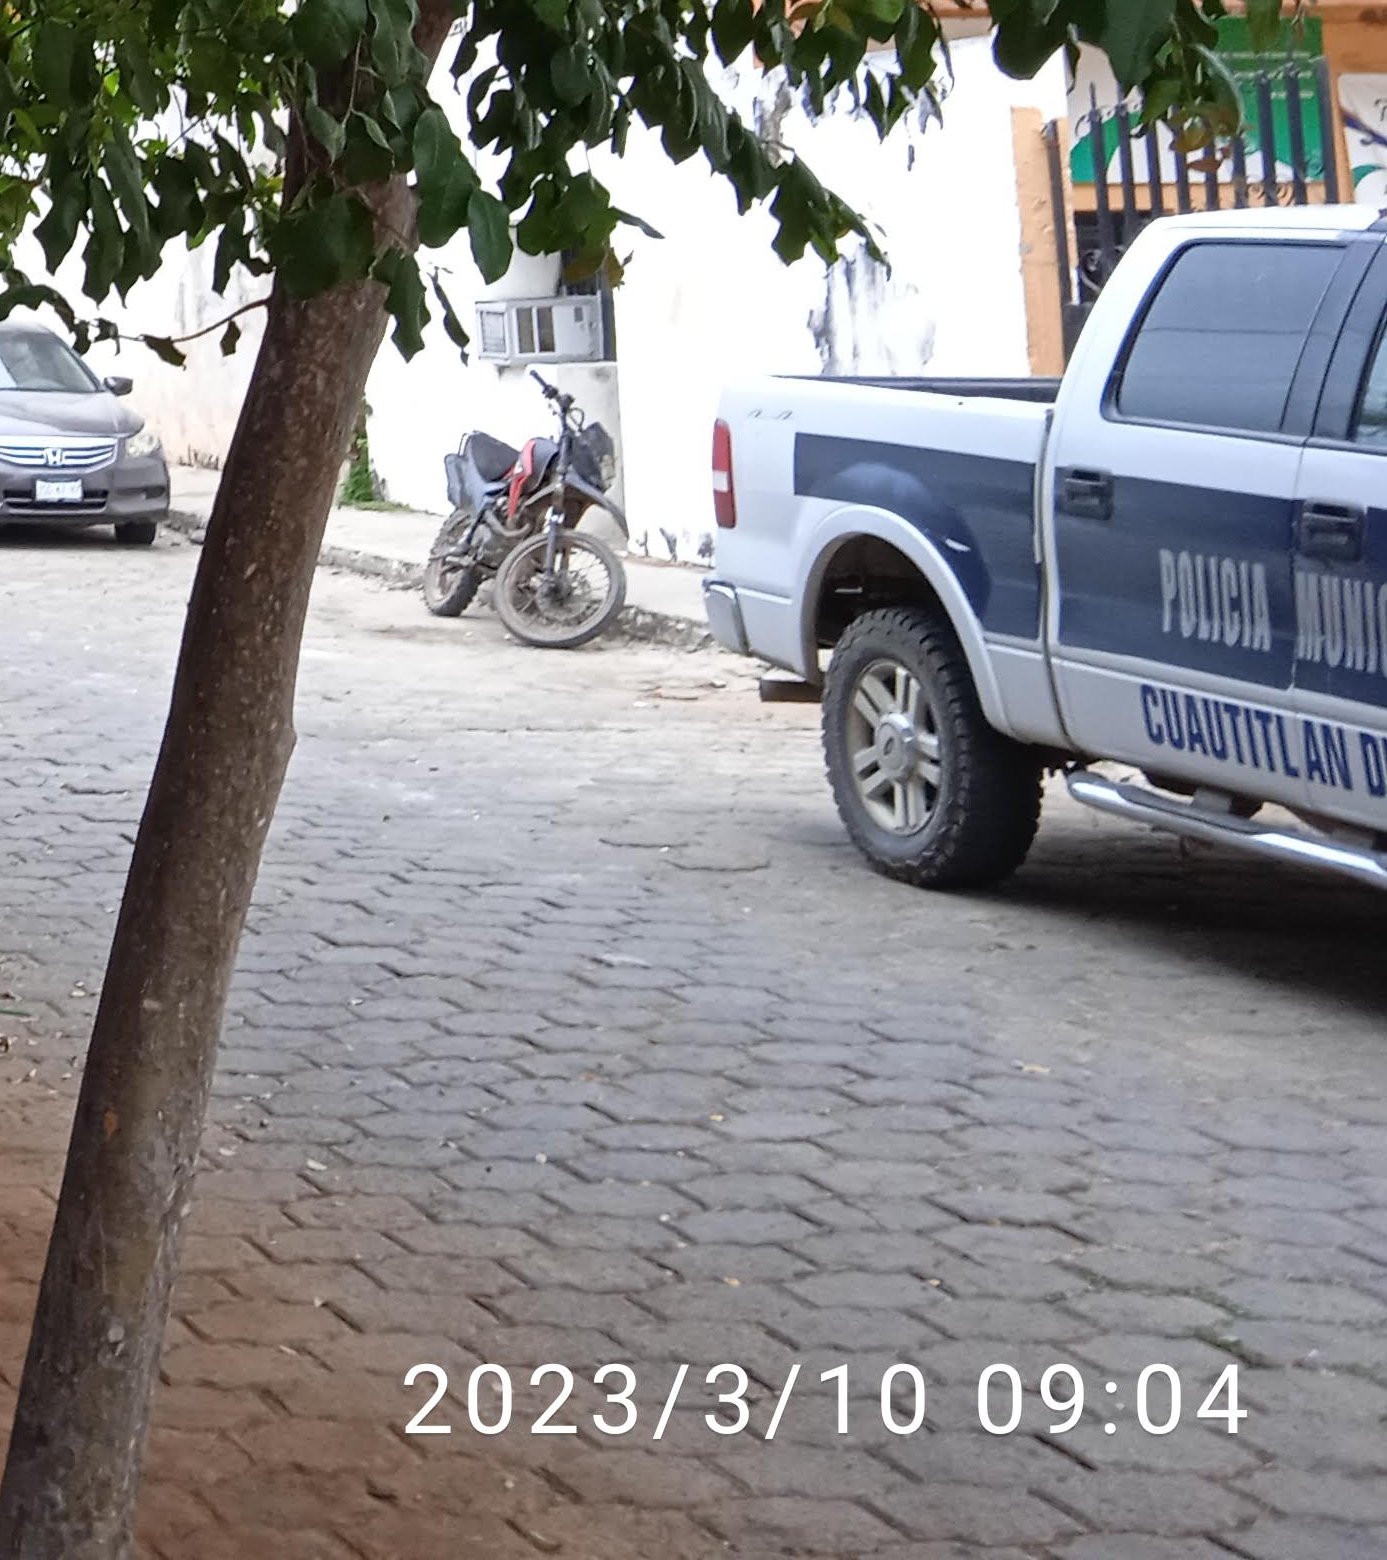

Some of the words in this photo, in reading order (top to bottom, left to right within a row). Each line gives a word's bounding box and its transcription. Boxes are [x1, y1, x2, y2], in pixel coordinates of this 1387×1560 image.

[1159, 548, 1271, 653] POLICIA
[1139, 683, 1353, 791] CUAUTITLAN
[1358, 731, 1387, 797] D
